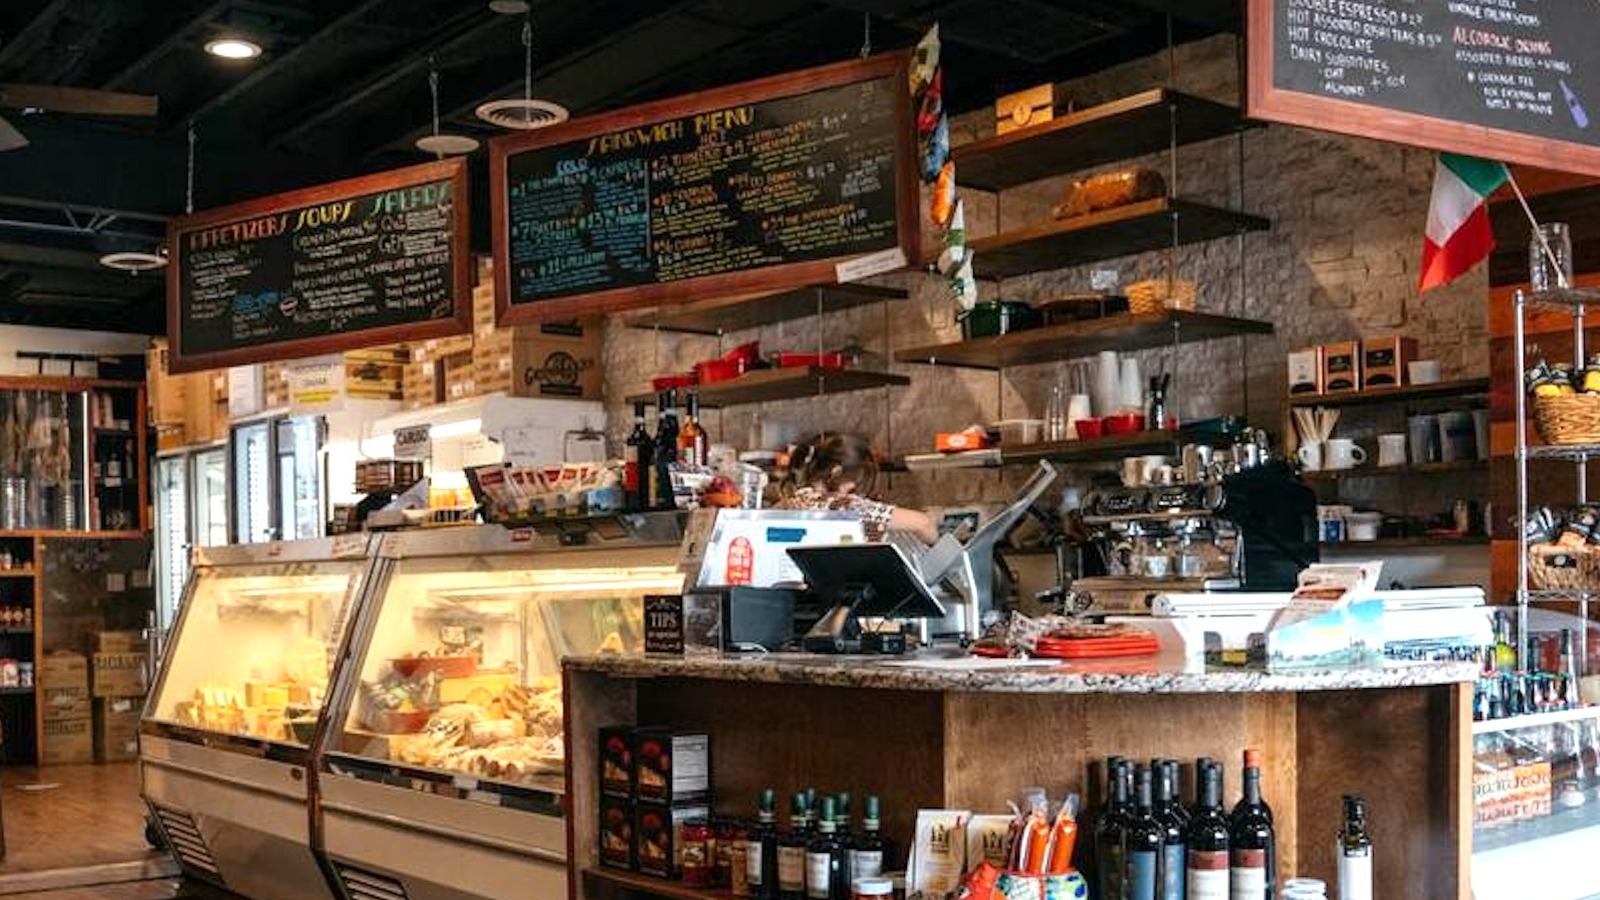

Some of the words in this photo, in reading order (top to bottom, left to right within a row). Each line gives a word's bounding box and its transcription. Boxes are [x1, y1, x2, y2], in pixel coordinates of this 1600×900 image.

[1288, 7, 1310, 24] HOT
[1338, 0, 1399, 26] ESPRESSO
[1288, 25, 1310, 42] HOT
[1314, 29, 1375, 54] CHOCOLATE
[1290, 43, 1322, 63] DAIRY
[1325, 51, 1390, 75] SUBSTITUTES
[585, 119, 685, 157] SANDWICH
[693, 106, 755, 137] MENU
[556, 158, 590, 177] COLD
[370, 184, 450, 217] SALADS
[295, 200, 358, 232] SOUPS
[649, 611, 678, 629] TIPS
